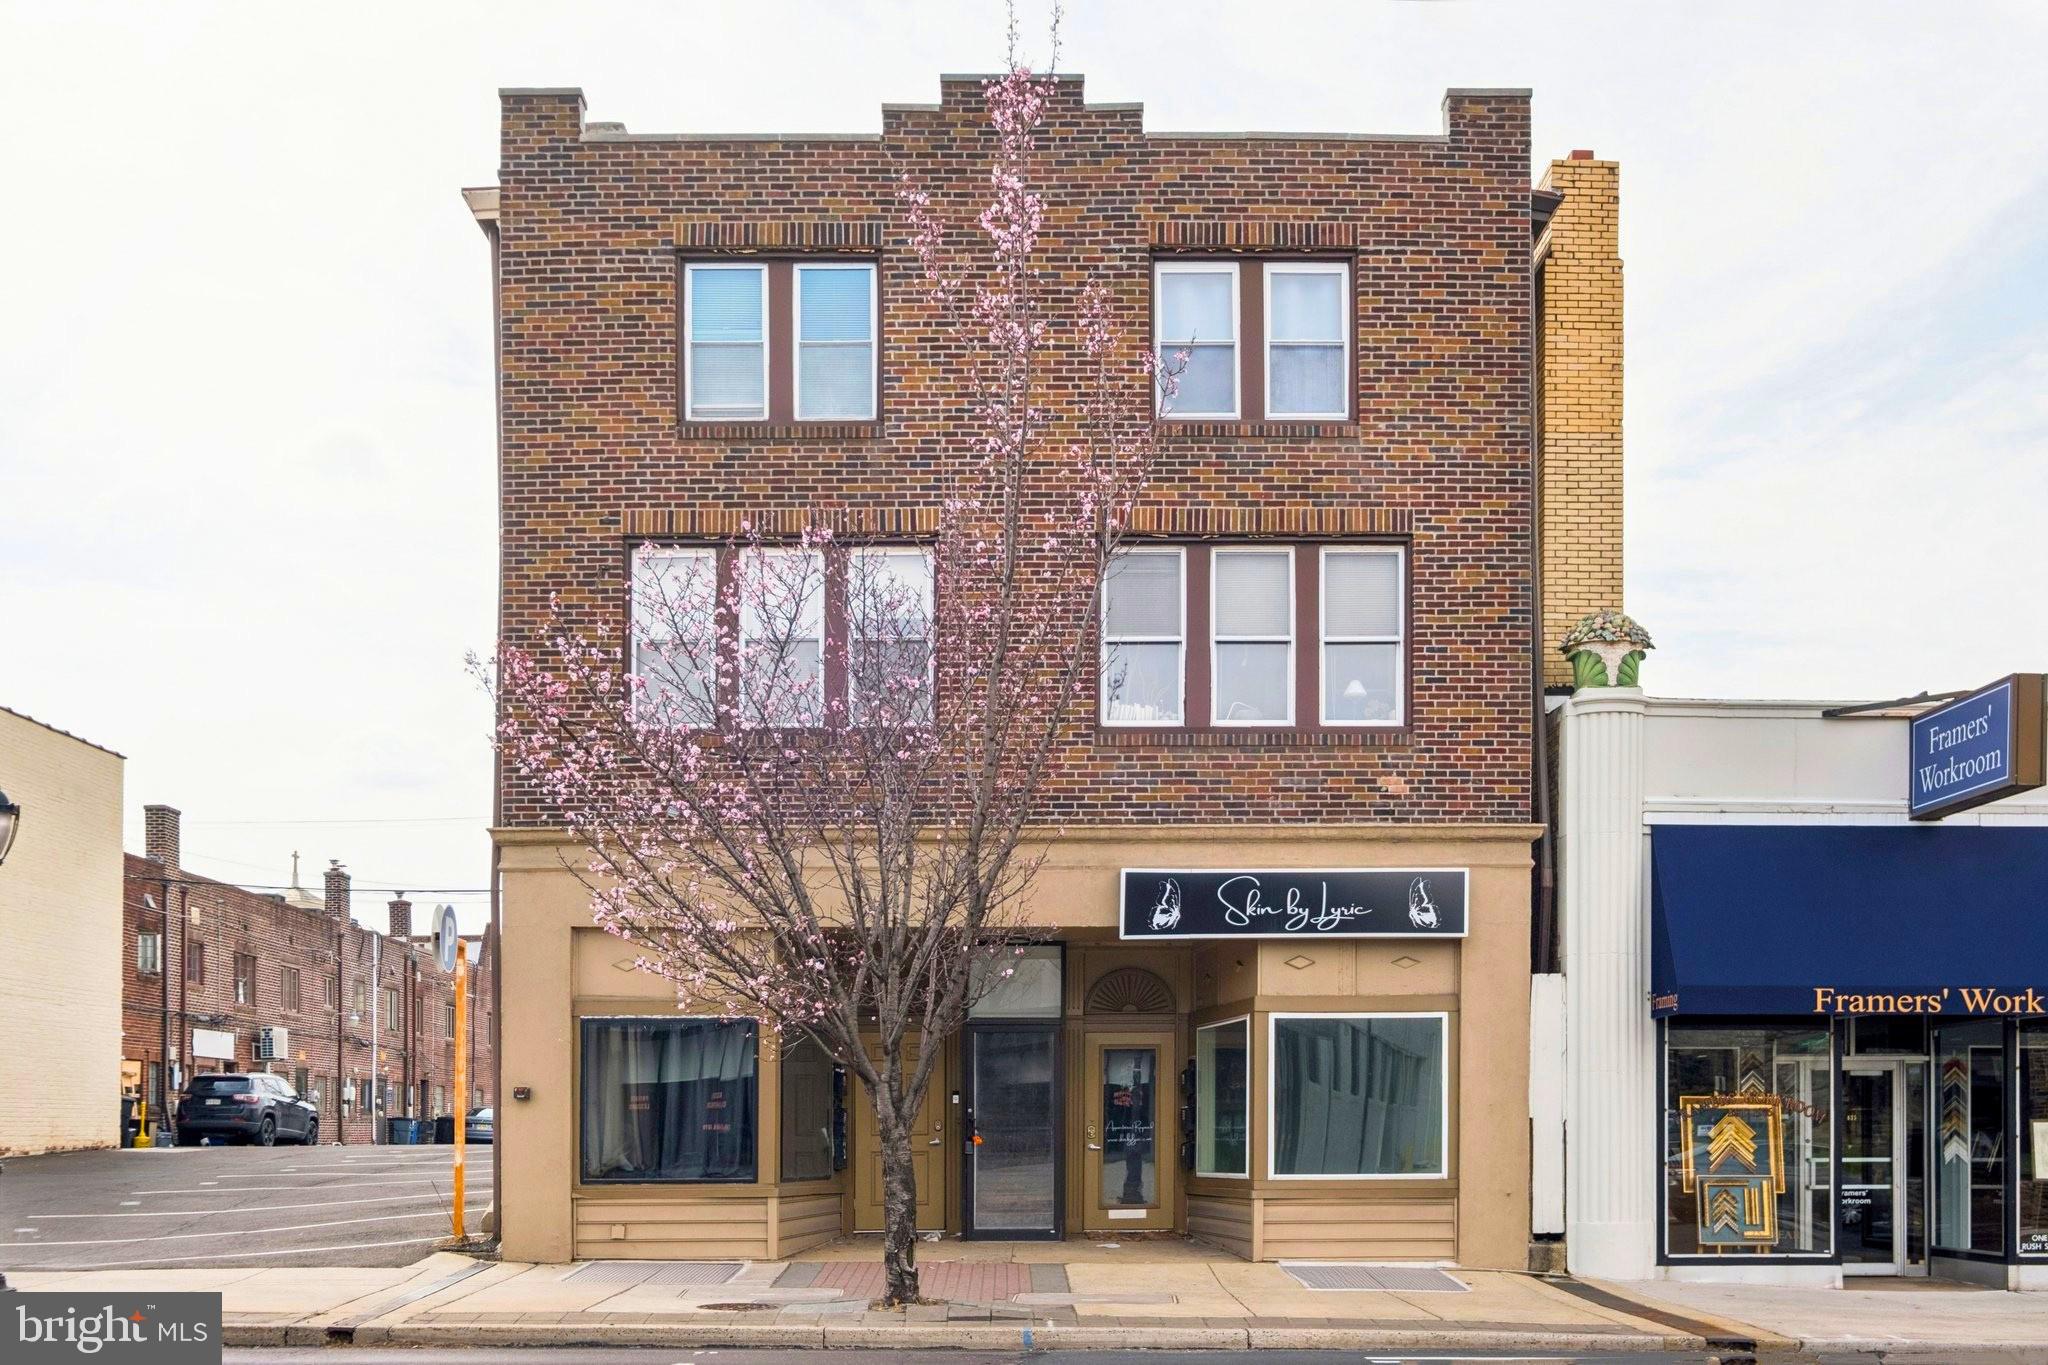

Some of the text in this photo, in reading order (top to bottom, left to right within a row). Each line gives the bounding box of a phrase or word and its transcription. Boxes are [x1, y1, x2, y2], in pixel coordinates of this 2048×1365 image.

[1928, 704, 1991, 754] Framers'
[1919, 749, 2001, 793] Workroom
[1217, 875, 1373, 931] Skin by Lyric
[445, 915, 455, 962] P
[1812, 987, 2047, 1014] Framers' Work
[2021, 1242, 2042, 1250] RUSH
[2031, 1234, 2048, 1242] ONE
